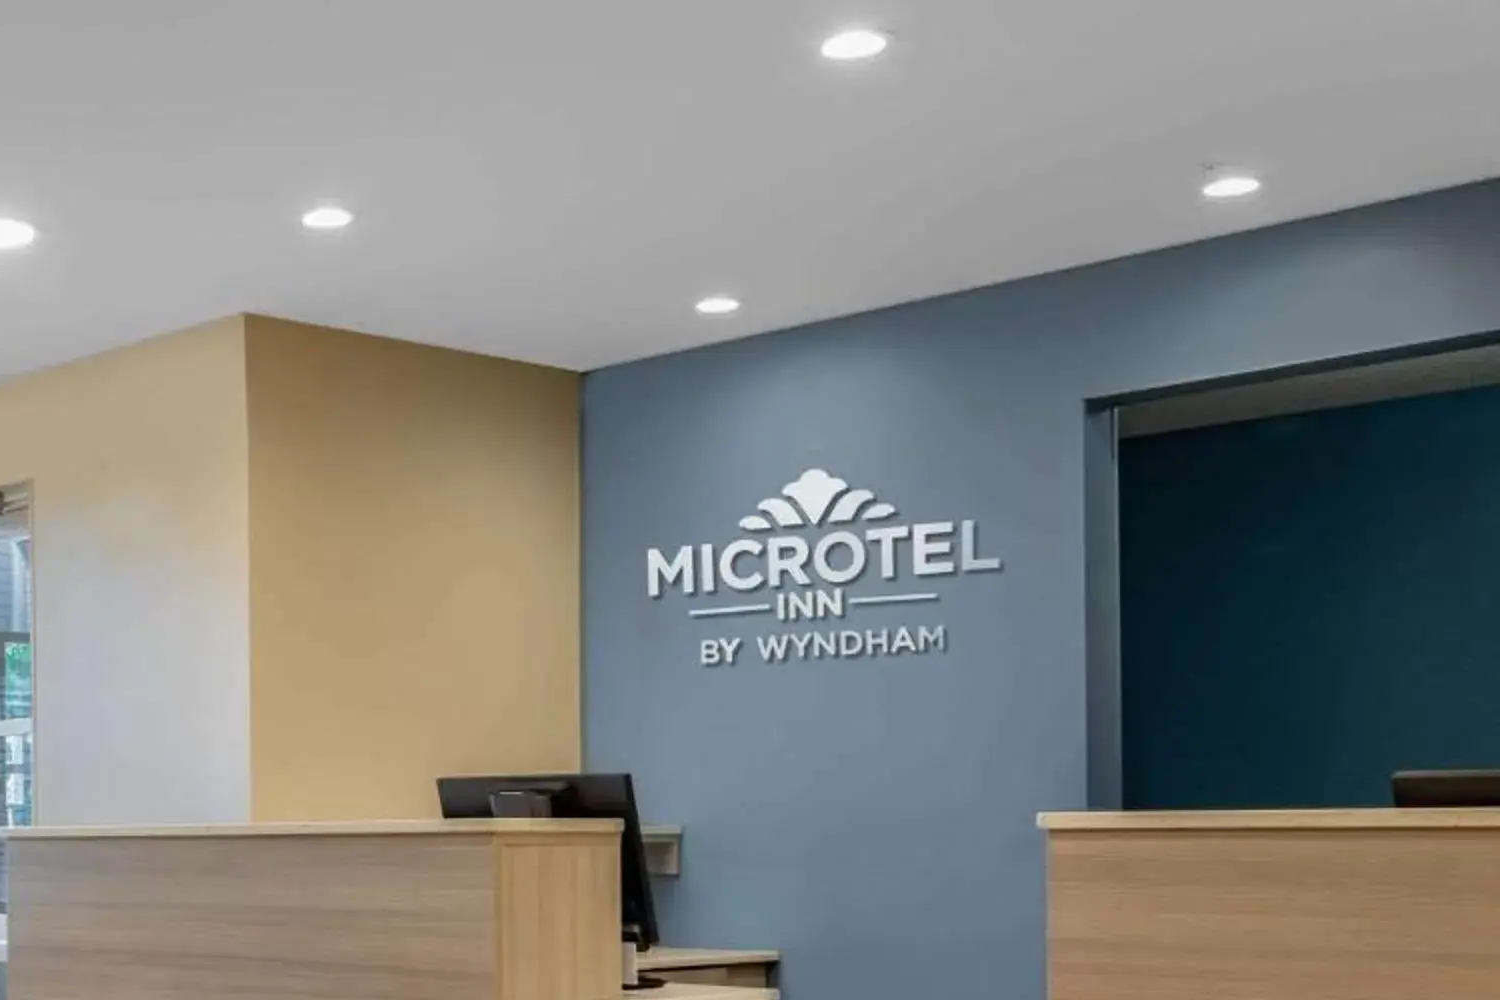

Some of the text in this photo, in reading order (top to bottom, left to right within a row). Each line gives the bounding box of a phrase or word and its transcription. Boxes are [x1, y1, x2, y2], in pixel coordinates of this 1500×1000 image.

[647, 520, 1001, 597] MICROTEL
[777, 588, 843, 620] INN
[701, 625, 947, 665] BY WYNDHAM
